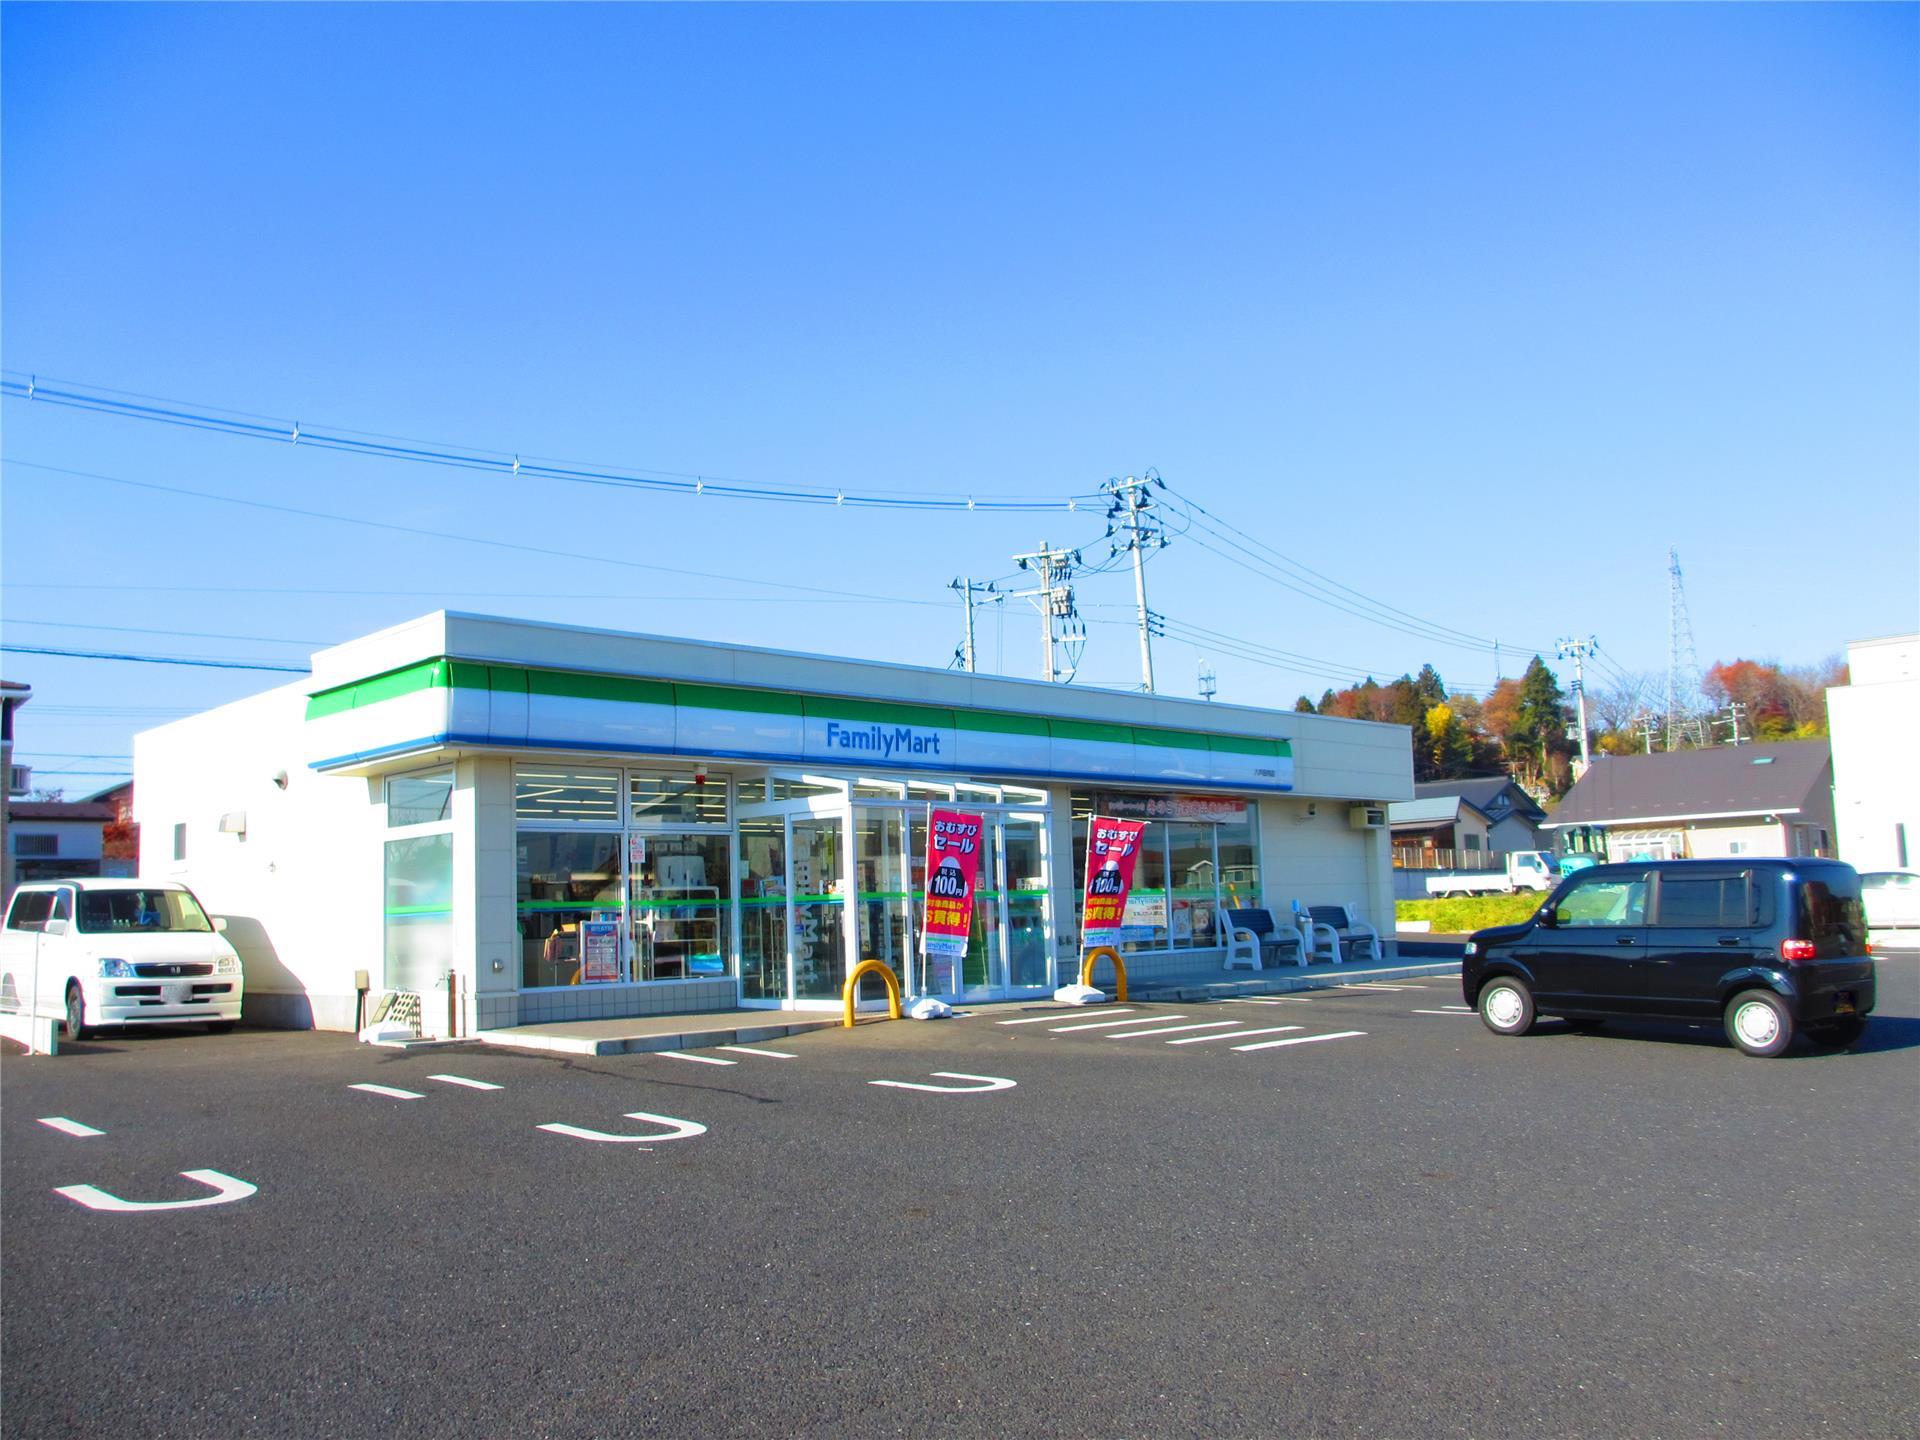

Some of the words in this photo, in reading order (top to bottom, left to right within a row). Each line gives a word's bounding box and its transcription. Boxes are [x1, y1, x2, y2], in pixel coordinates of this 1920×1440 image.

[827, 722, 940, 758] FamilyMart
[934, 820, 978, 837] おむすび
[933, 834, 976, 854] セール
[1095, 840, 1135, 857] セール
[934, 875, 963, 897] 100円
